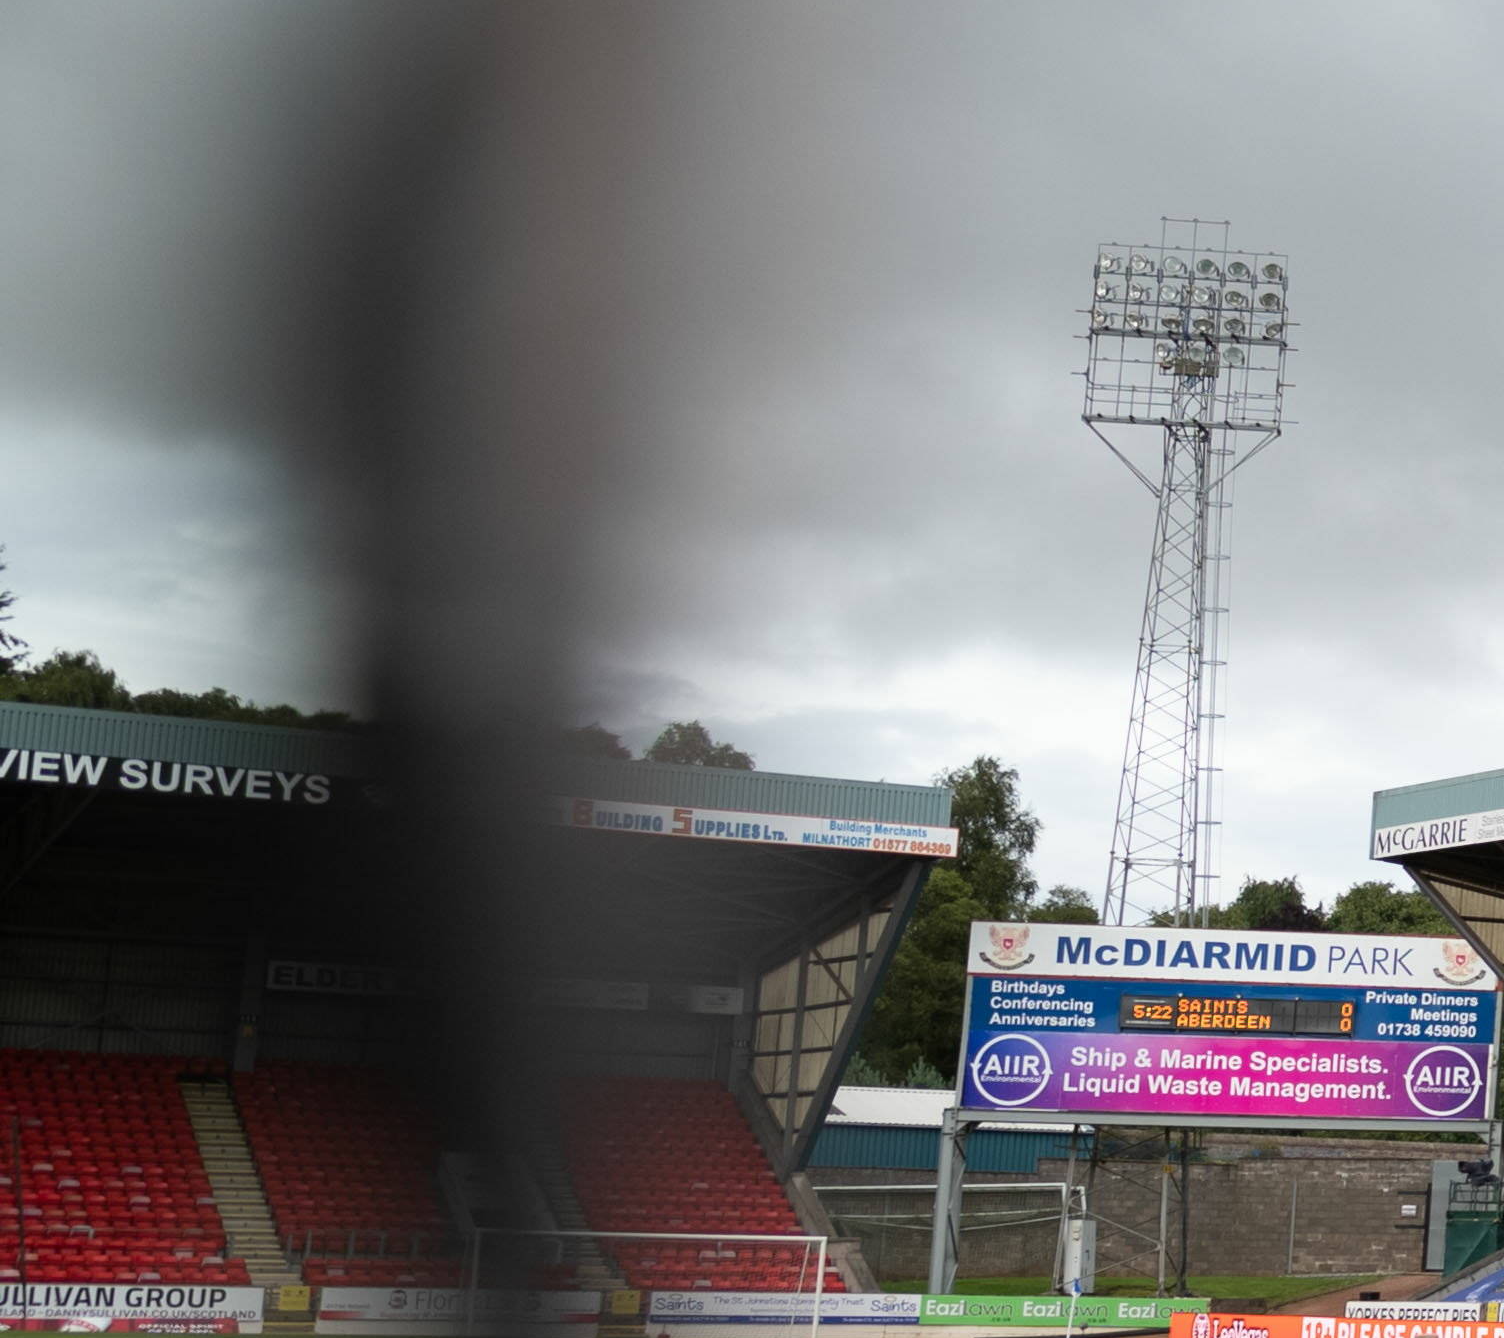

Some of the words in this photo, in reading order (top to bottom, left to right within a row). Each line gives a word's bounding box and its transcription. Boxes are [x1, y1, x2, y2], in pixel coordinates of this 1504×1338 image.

[119, 759, 331, 804] SURVEYS
[672, 808, 760, 840] SUPPLIES
[830, 821, 872, 836] Building
[875, 824, 927, 838] Merchants
[803, 833, 871, 847] MILNATHORT
[873, 838, 907, 851] 01577
[1376, 819, 1467, 854] McGARRIE
[1056, 935, 1317, 974] McDIARMID
[1328, 946, 1414, 977] PARK
[991, 980, 1065, 996] Birthdays
[990, 996, 1094, 1015] Conferencing
[1178, 999, 1249, 1014] SAINTS
[1366, 990, 1417, 1007] Private
[1419, 993, 1479, 1008] Dinners
[989, 1012, 1096, 1029] Anniversaries
[1133, 1004, 1172, 1021] 5:22
[1411, 1008, 1478, 1025] Meetings
[1177, 1014, 1271, 1030] ABERDEEN
[1377, 1022, 1422, 1037] 01738
[1425, 1024, 1477, 1039] 459090
[984, 1056, 1040, 1078] AIIR
[1071, 1045, 1127, 1074] Ship
[1133, 1048, 1152, 1069] &
[1159, 1049, 1243, 1073] Marine
[1249, 1051, 1389, 1080] Specialists.
[981, 1074, 1042, 1085] Environmental
[1417, 1064, 1471, 1087] AIIR
[1062, 1072, 1140, 1098] Liquid
[1147, 1074, 1222, 1096] Waste
[1229, 1077, 1393, 1105] Management.
[1414, 1084, 1473, 1096] Environmental
[126, 1287, 227, 1309] GROUP
[654, 1297, 704, 1311] Saints
[871, 1299, 916, 1313] Saints
[926, 1300, 1012, 1317] Eazilawn
[1023, 1301, 1108, 1317] Eazilawn
